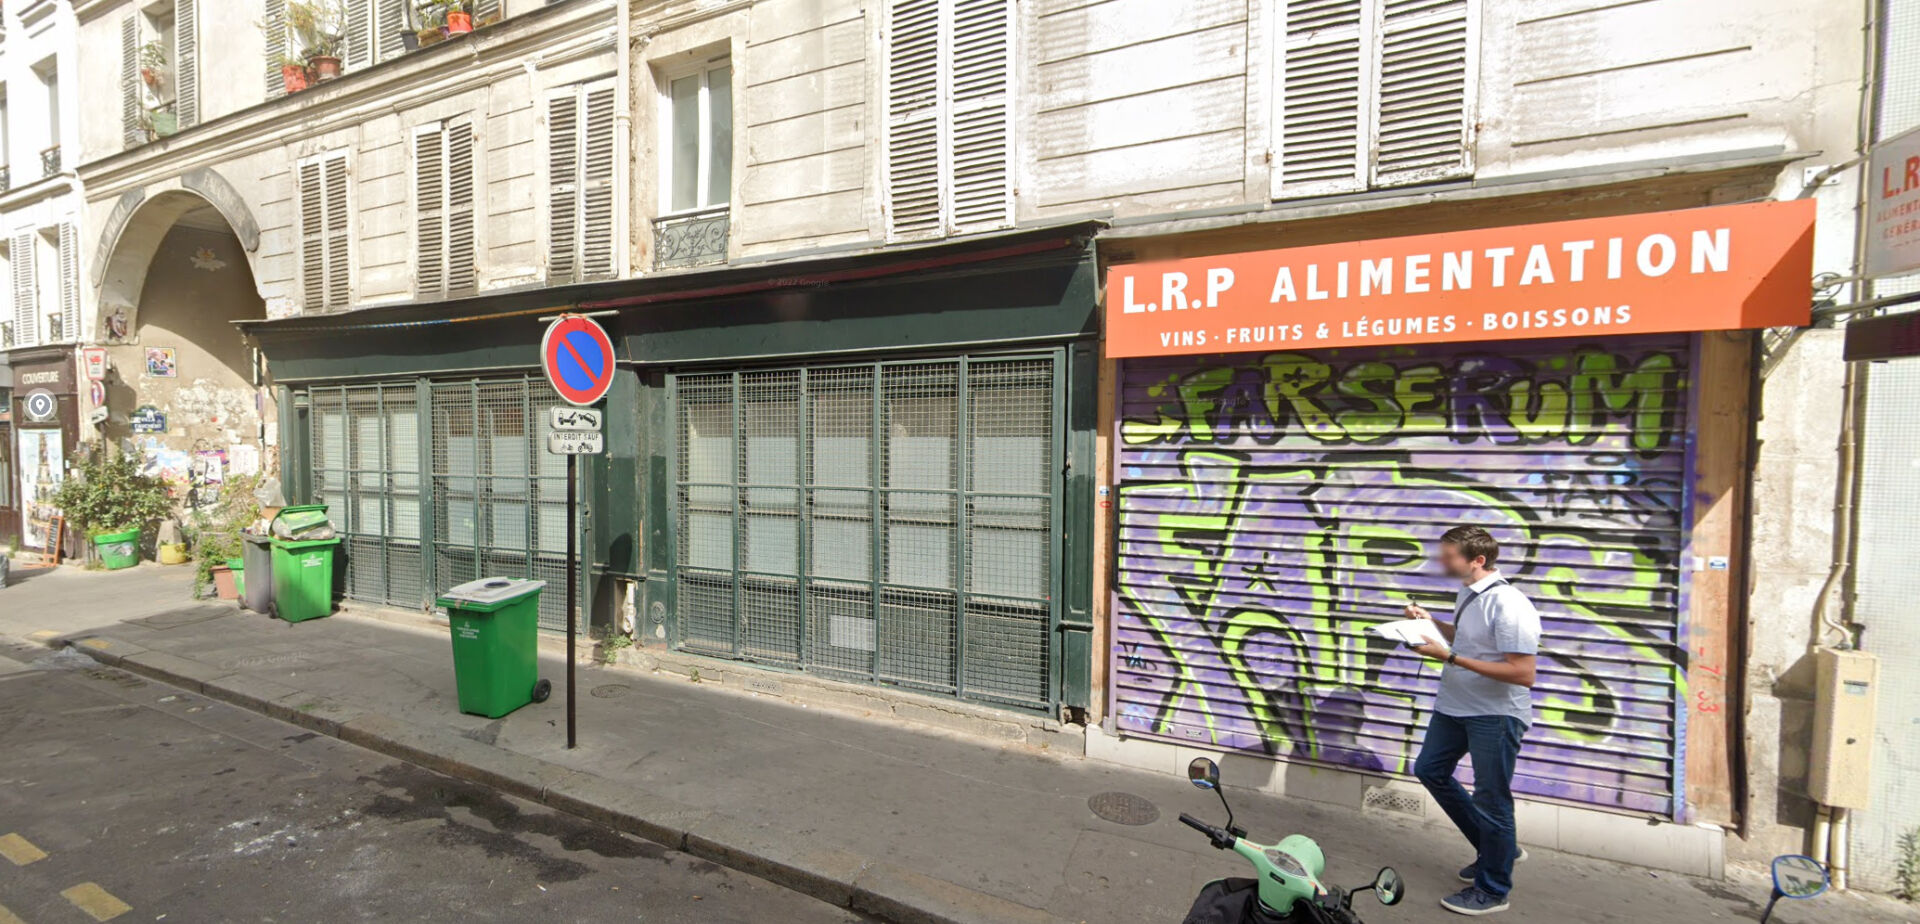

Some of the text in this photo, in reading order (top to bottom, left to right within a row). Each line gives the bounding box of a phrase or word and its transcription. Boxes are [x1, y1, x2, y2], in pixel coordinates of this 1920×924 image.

[1123, 228, 1730, 314] L.R.P ALIMENTATION
[1160, 304, 1631, 347] VINS FRUITS & LÉGUMES BOISSONS
